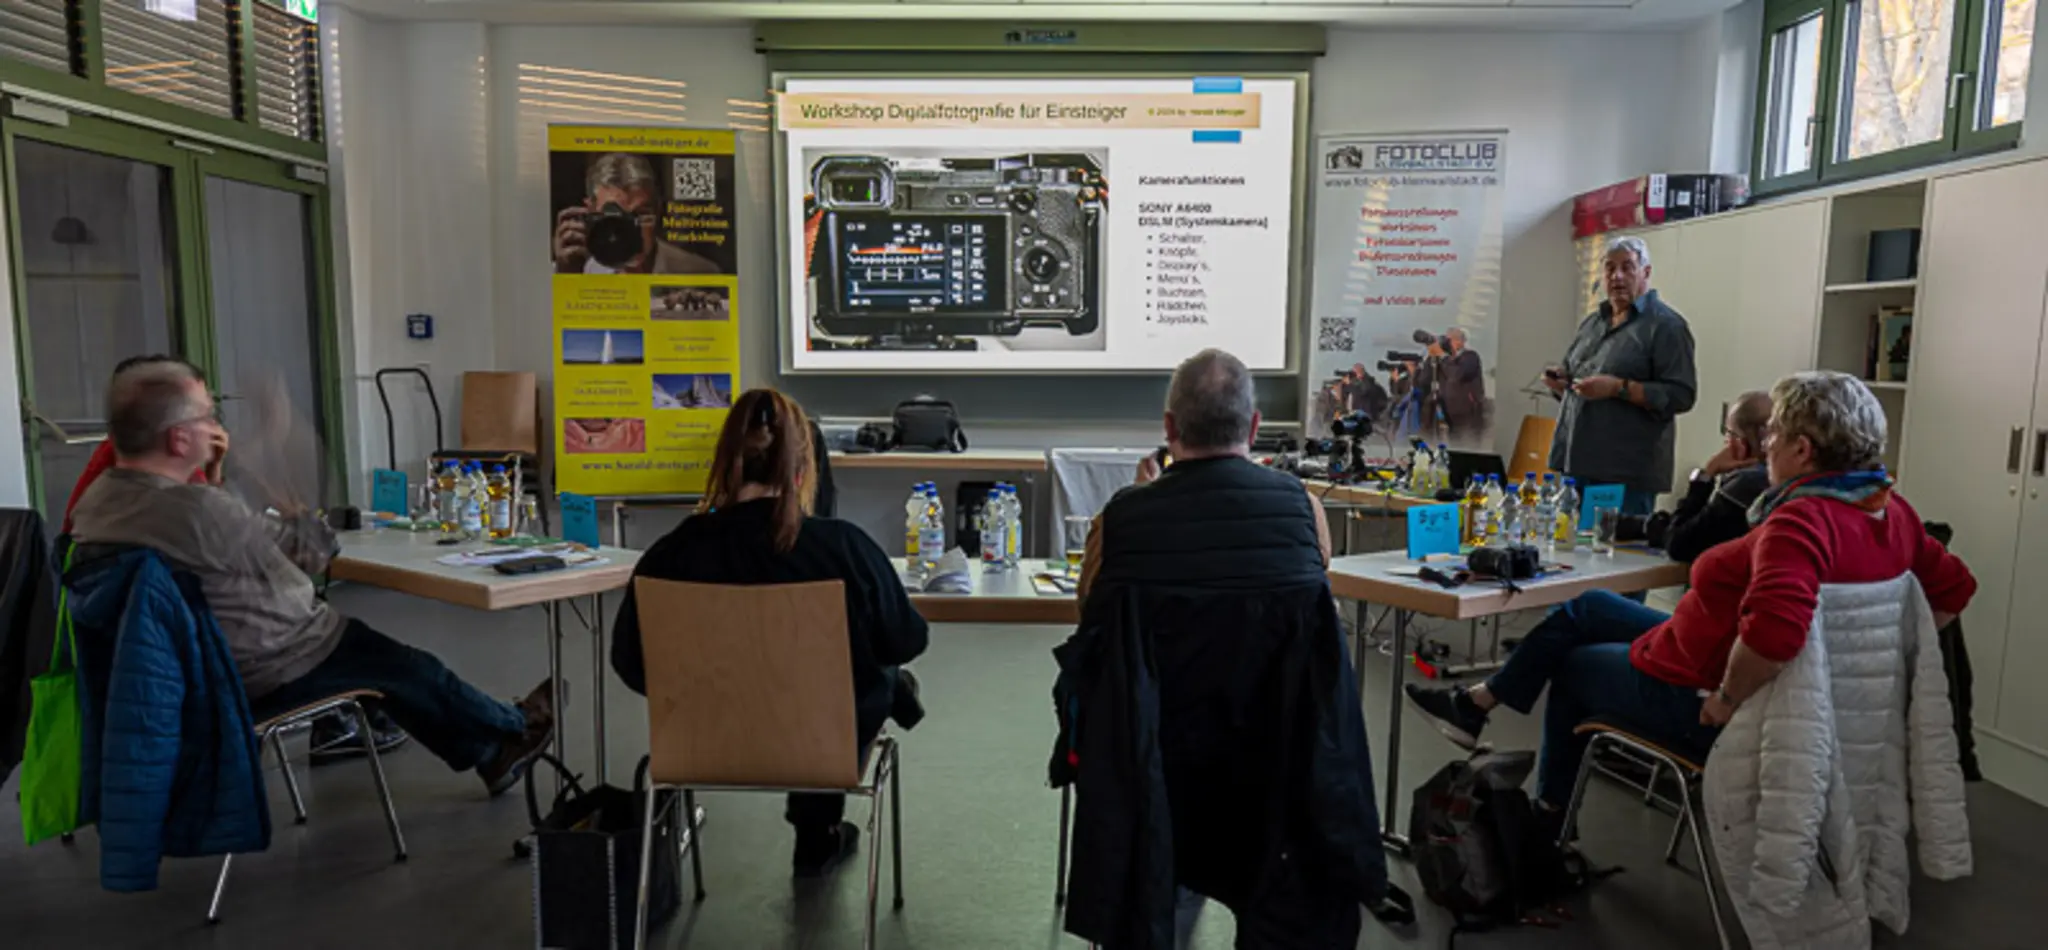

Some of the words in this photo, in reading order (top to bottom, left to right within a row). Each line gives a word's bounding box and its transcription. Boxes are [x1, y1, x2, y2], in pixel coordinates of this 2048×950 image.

[800, 103, 883, 120] Workshop
[888, 102, 1014, 123] Digitalfotografie
[1020, 102, 1040, 119] für
[1046, 103, 1127, 123] Einsteiger
[1375, 143, 1498, 161] FOTOCLUB
[1138, 174, 1246, 186] Kamerafunktionen
[667, 202, 723, 216] Fotografie
[1138, 202, 1173, 213] SONY
[662, 216, 729, 229] Multivision
[1174, 216, 1268, 230] (Systemkamera)
[667, 232, 725, 245] Workshop
[581, 459, 713, 471] www.harald-metzger.d
